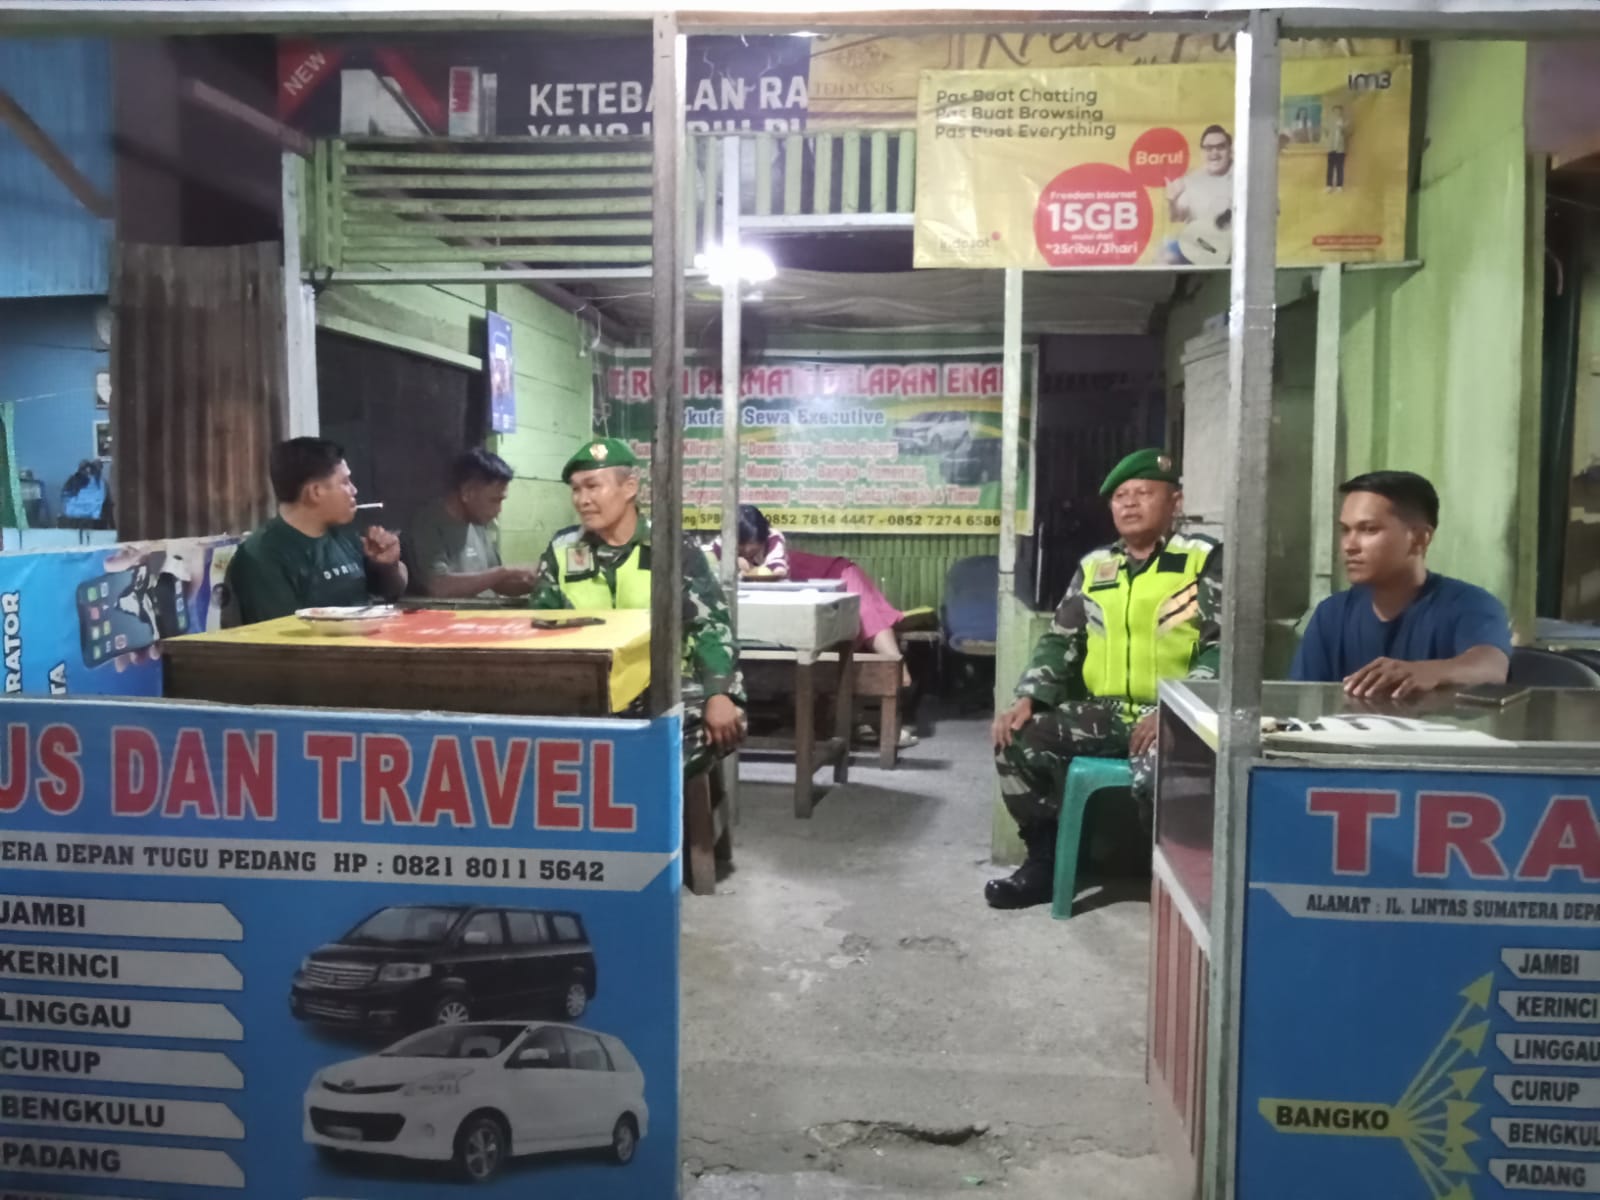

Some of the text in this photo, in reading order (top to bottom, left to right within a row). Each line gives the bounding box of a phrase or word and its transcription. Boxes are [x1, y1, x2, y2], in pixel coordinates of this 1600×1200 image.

[283, 51, 327, 96] NEW
[529, 79, 745, 116] KETEBAN
[937, 87, 1098, 106] Pas Buat Chatting
[972, 106, 1015, 120] Buat
[1019, 107, 1104, 121] Browsing
[936, 126, 966, 139] Pas
[1018, 122, 1117, 140] Everything
[1135, 150, 1184, 165] Baru!
[1047, 201, 1139, 232] 15GB
[744, 408, 790, 425] Sewa
[797, 407, 884, 425] Executive
[766, 514, 797, 525] 0852
[802, 514, 835, 525] 7814
[888, 514, 922, 526] 0852
[928, 515, 962, 526] 7274
[111, 725, 277, 820] DAN
[303, 731, 638, 833] TRAVEL
[1306, 787, 1600, 884] TRA
[0, 841, 48, 862] ERA
[56, 843, 134, 866] DEPAN
[143, 847, 209, 869] TUGU
[218, 849, 317, 872] PEDANG
[333, 852, 368, 873] HP
[392, 855, 453, 877] 0821
[465, 856, 527, 879] 8011
[539, 859, 605, 882] 5642
[0, 901, 86, 927] JAMBI
[1306, 894, 1371, 914] ALAMAT
[1411, 897, 1468, 917] LINTAS
[1473, 900, 1559, 920] SUMATERA
[0, 949, 119, 979] KERINCI
[1518, 953, 1580, 975] JAMBI
[0, 998, 131, 1028] LINGGAU
[1516, 995, 1598, 1018] KERINCI
[0, 1046, 101, 1074] CURUP
[1513, 1038, 1600, 1061] LINGGAU
[1511, 1080, 1580, 1102] CURUP
[1, 1095, 165, 1128] BENGKULU
[1276, 1104, 1390, 1131] BANGKO
[2, 1142, 121, 1173] PADANG
[1505, 1163, 1586, 1187] PADANG
